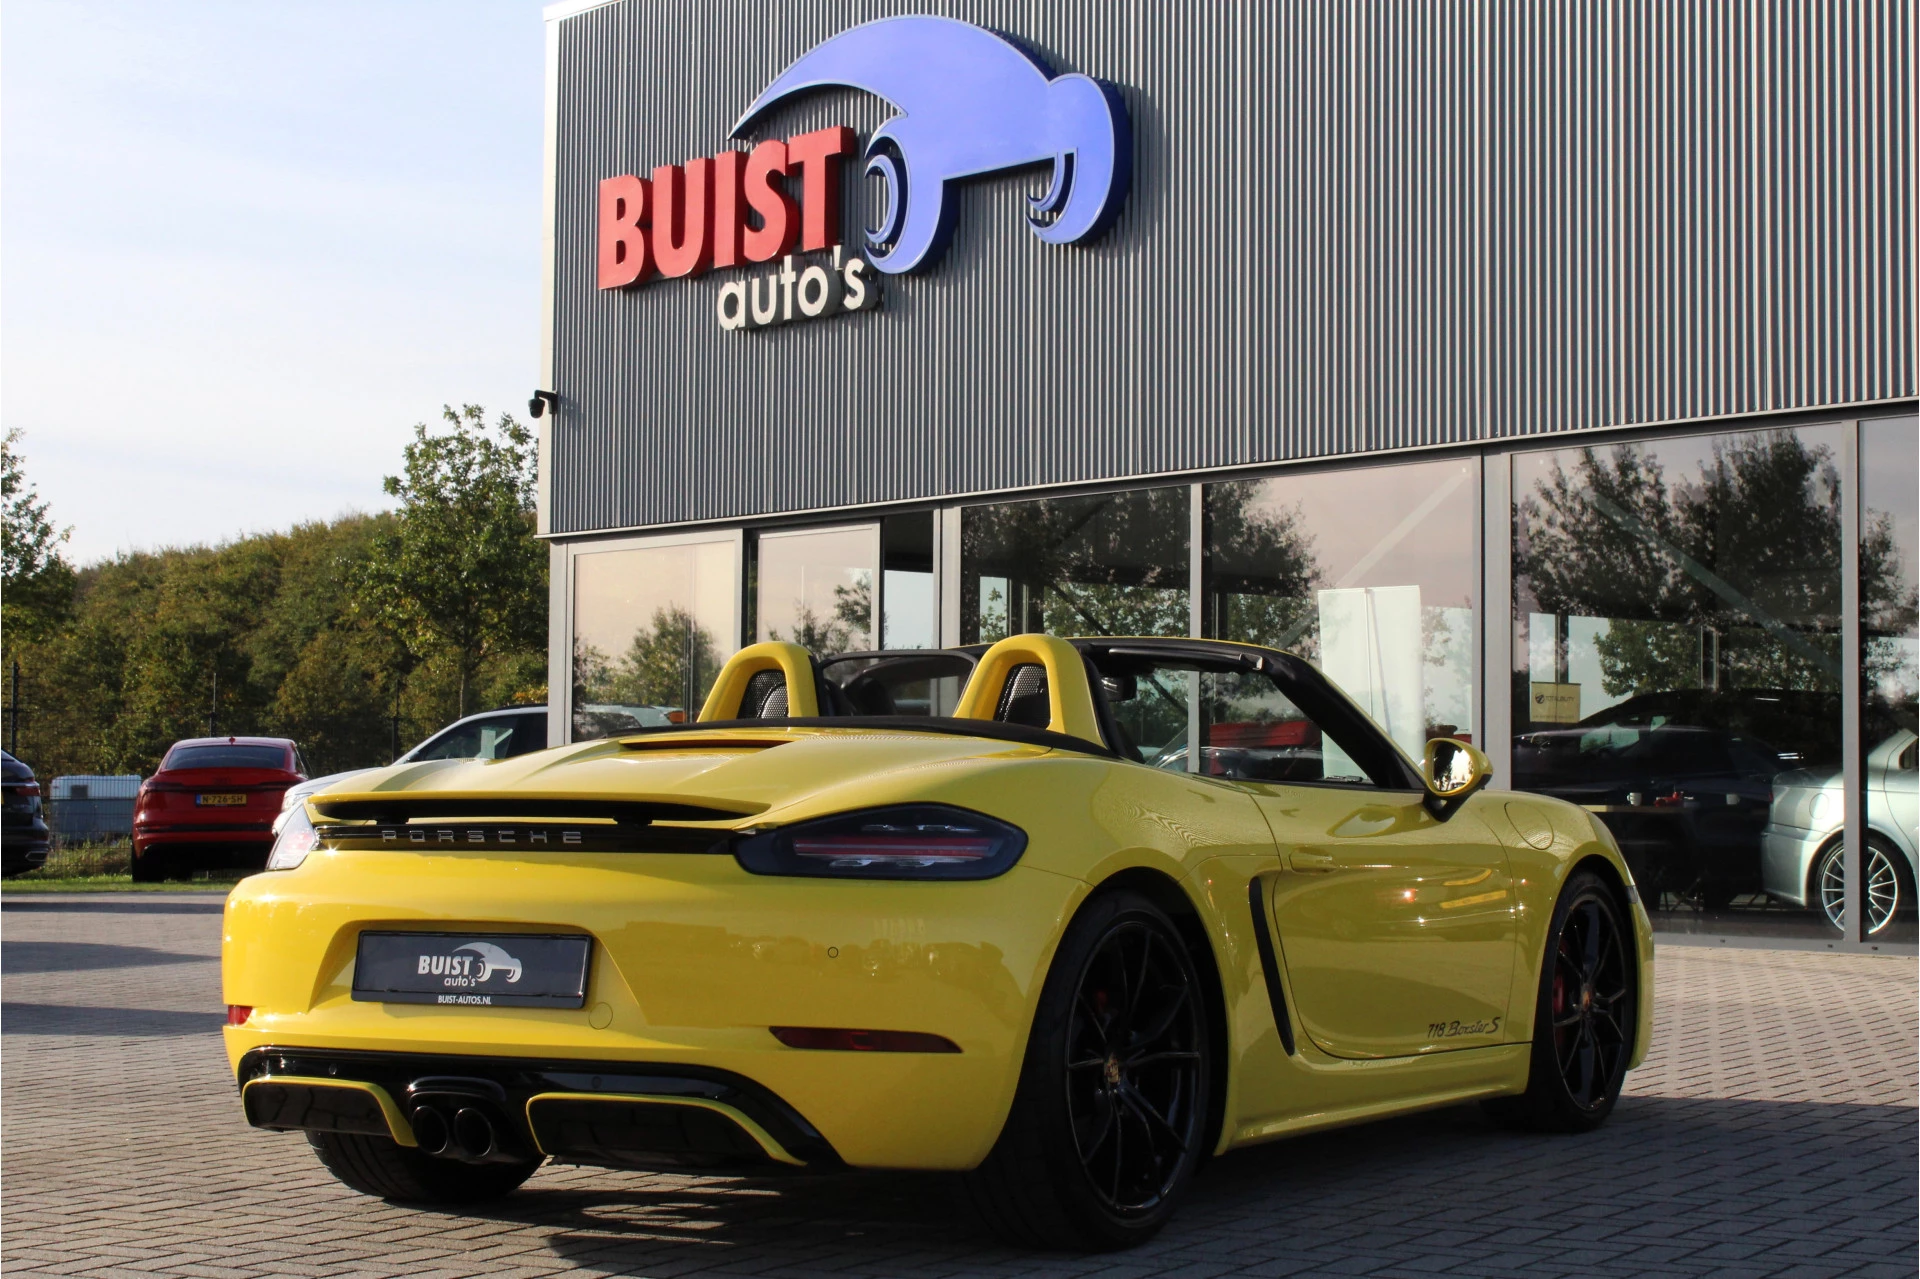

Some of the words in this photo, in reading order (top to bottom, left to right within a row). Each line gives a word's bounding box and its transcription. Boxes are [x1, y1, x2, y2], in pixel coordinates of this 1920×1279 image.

[598, 126, 852, 290] BUIST
[717, 245, 872, 331] auto's
[202, 795, 243, 804] N-726-SH
[381, 829, 582, 844] PORSCHE
[417, 955, 475, 975] BUIST
[444, 975, 476, 987] auto's
[438, 995, 491, 1005] BUIST-AUTOS.NL
[1428, 1022, 1446, 1038] 718
[1445, 1020, 1489, 1037] Boxster
[1485, 1016, 1501, 1034] S
